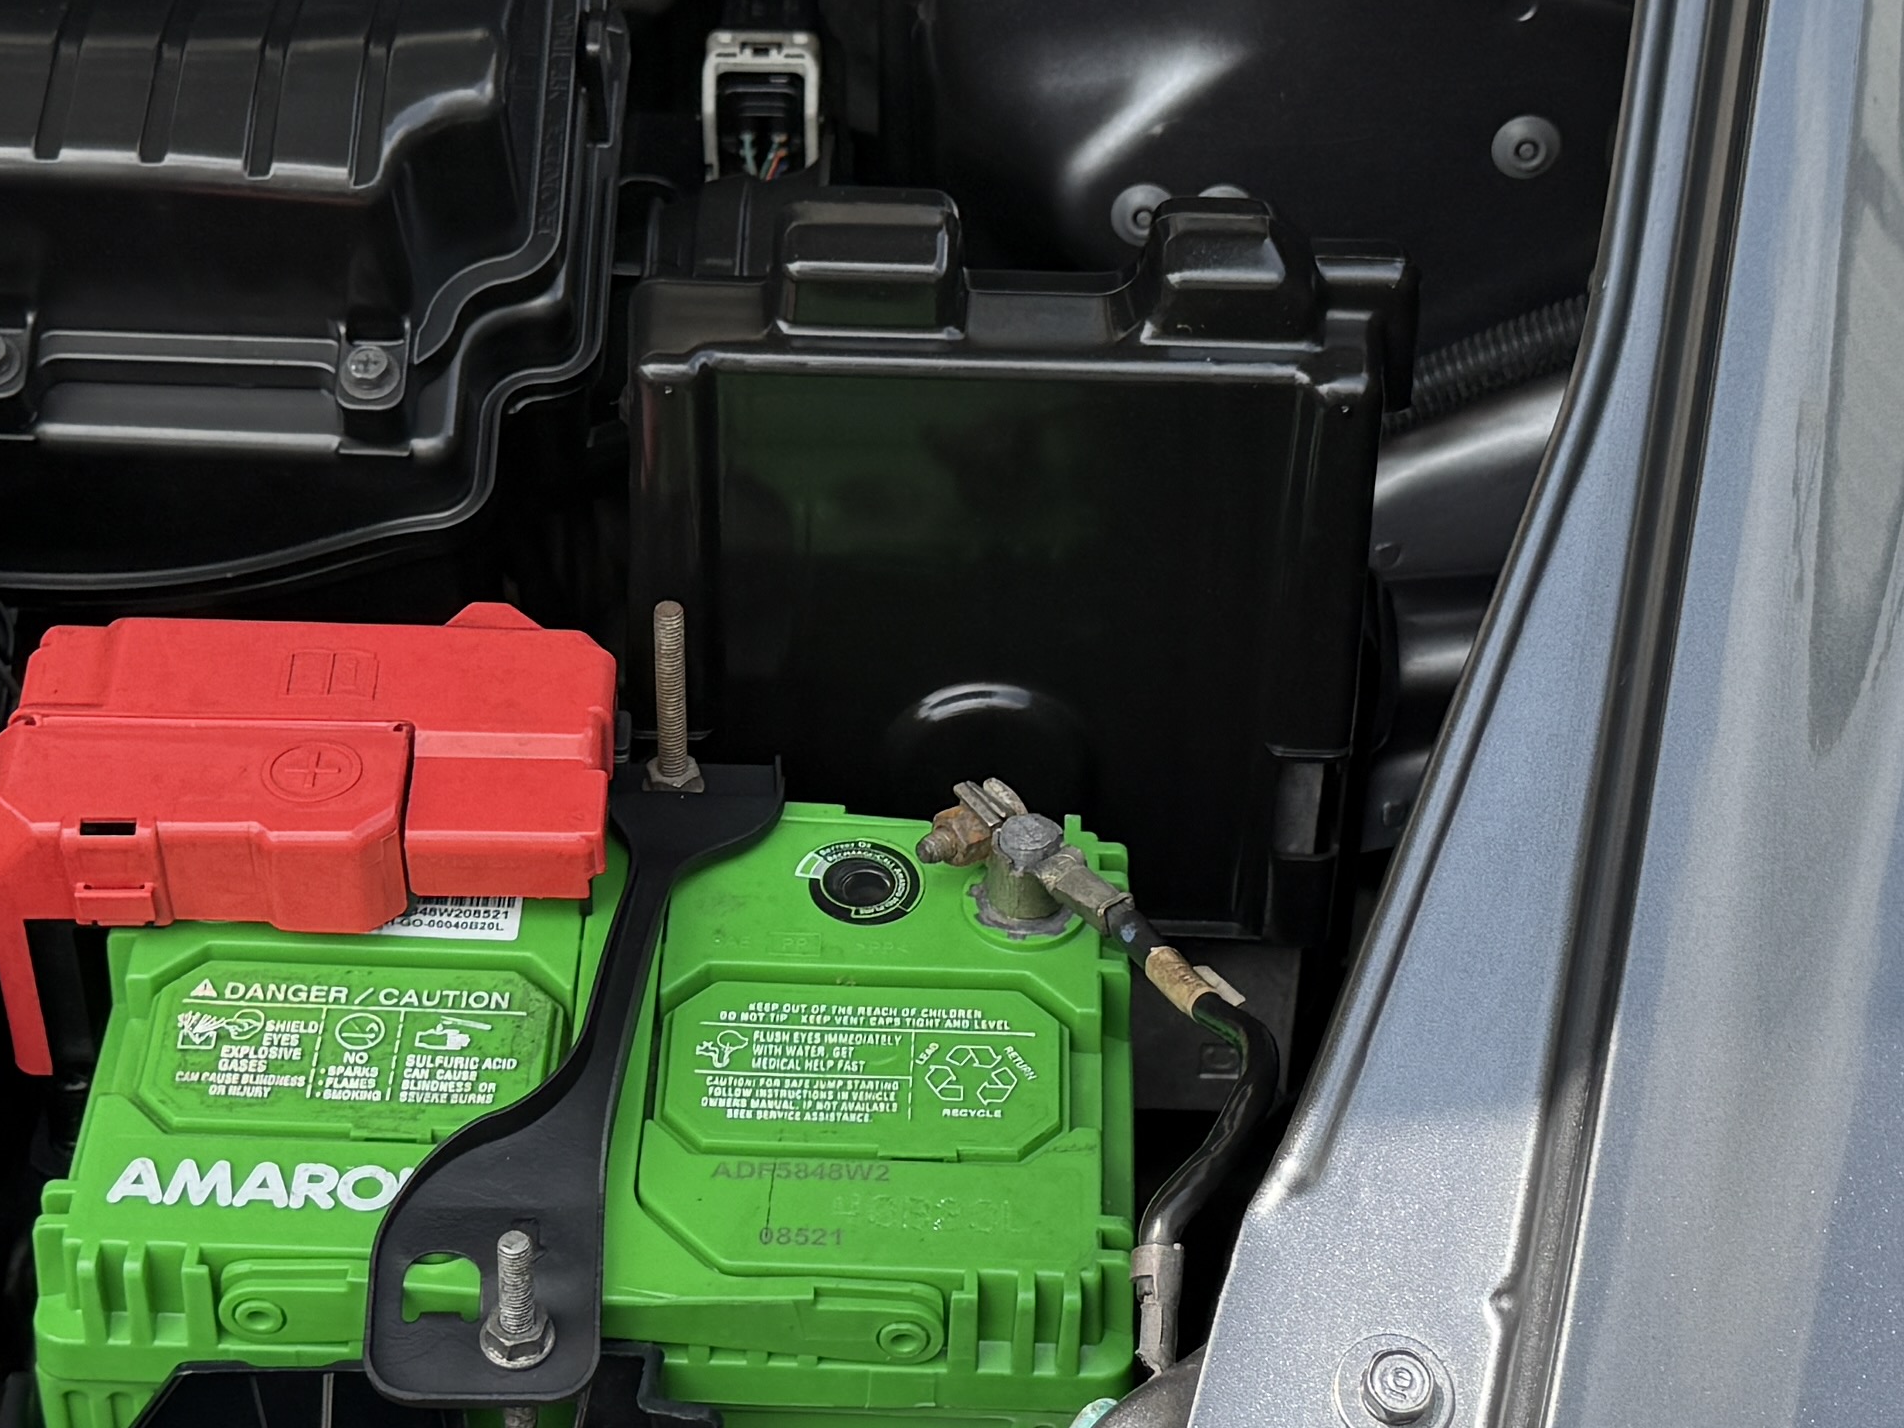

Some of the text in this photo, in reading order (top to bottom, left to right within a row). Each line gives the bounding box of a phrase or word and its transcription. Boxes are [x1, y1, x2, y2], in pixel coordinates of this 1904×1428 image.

[224, 981, 348, 1003] DANGER
[379, 988, 510, 1009] CAUTION
[719, 1011, 788, 1022] DO NOT TIP
[748, 1002, 982, 1019] KEEP OUT OF THE REACH OF CHILDREN
[265, 1019, 319, 1034] SHIELD
[800, 1014, 1010, 1031] KEEP VENT CAPS TIGHT AND LEVEL
[262, 1033, 300, 1047] EYES
[753, 1030, 902, 1046] FLUSH EYES IMMEDIATELY
[220, 1045, 302, 1061] EXPLOSIVE
[343, 1052, 369, 1065] NO
[752, 1044, 782, 1057] WITH
[833, 1046, 854, 1059] GET
[915, 1042, 940, 1065] LEAD
[218, 1059, 267, 1073] GASES
[405, 1054, 517, 1071] SULFURIC ACID
[752, 1057, 866, 1073] MEDICAL HELP FAST
[1003, 1045, 1038, 1081] RETURN
[175, 1071, 306, 1088] CAN CAUSE BLINDNESS
[327, 1066, 379, 1078] SPARKS
[403, 1068, 478, 1082] CAN CAUSE
[325, 1077, 376, 1089] FLAMES
[401, 1079, 497, 1093] BLINDNESS OR
[759, 1077, 781, 1088] FOR
[784, 1078, 810, 1089] SAFE
[813, 1079, 844, 1090] JUMP
[847, 1079, 899, 1091] STARTING
[208, 1084, 271, 1098] OR INJURY
[323, 1089, 382, 1102] SMOKING
[399, 1091, 494, 1105] SEVERE BURNS
[708, 1086, 896, 1102] FOLLOW INSTRUCTIONS IN VEHICLE
[701, 1097, 747, 1108] OWNERS
[802, 1100, 813, 1110] IF
[816, 1100, 837, 1111] NOT
[840, 1101, 898, 1113] AVAILABLE
[756, 1110, 801, 1121] SERVICE
[941, 1108, 1002, 1119] RECYCLE
[759, 1227, 843, 1246] 08521
